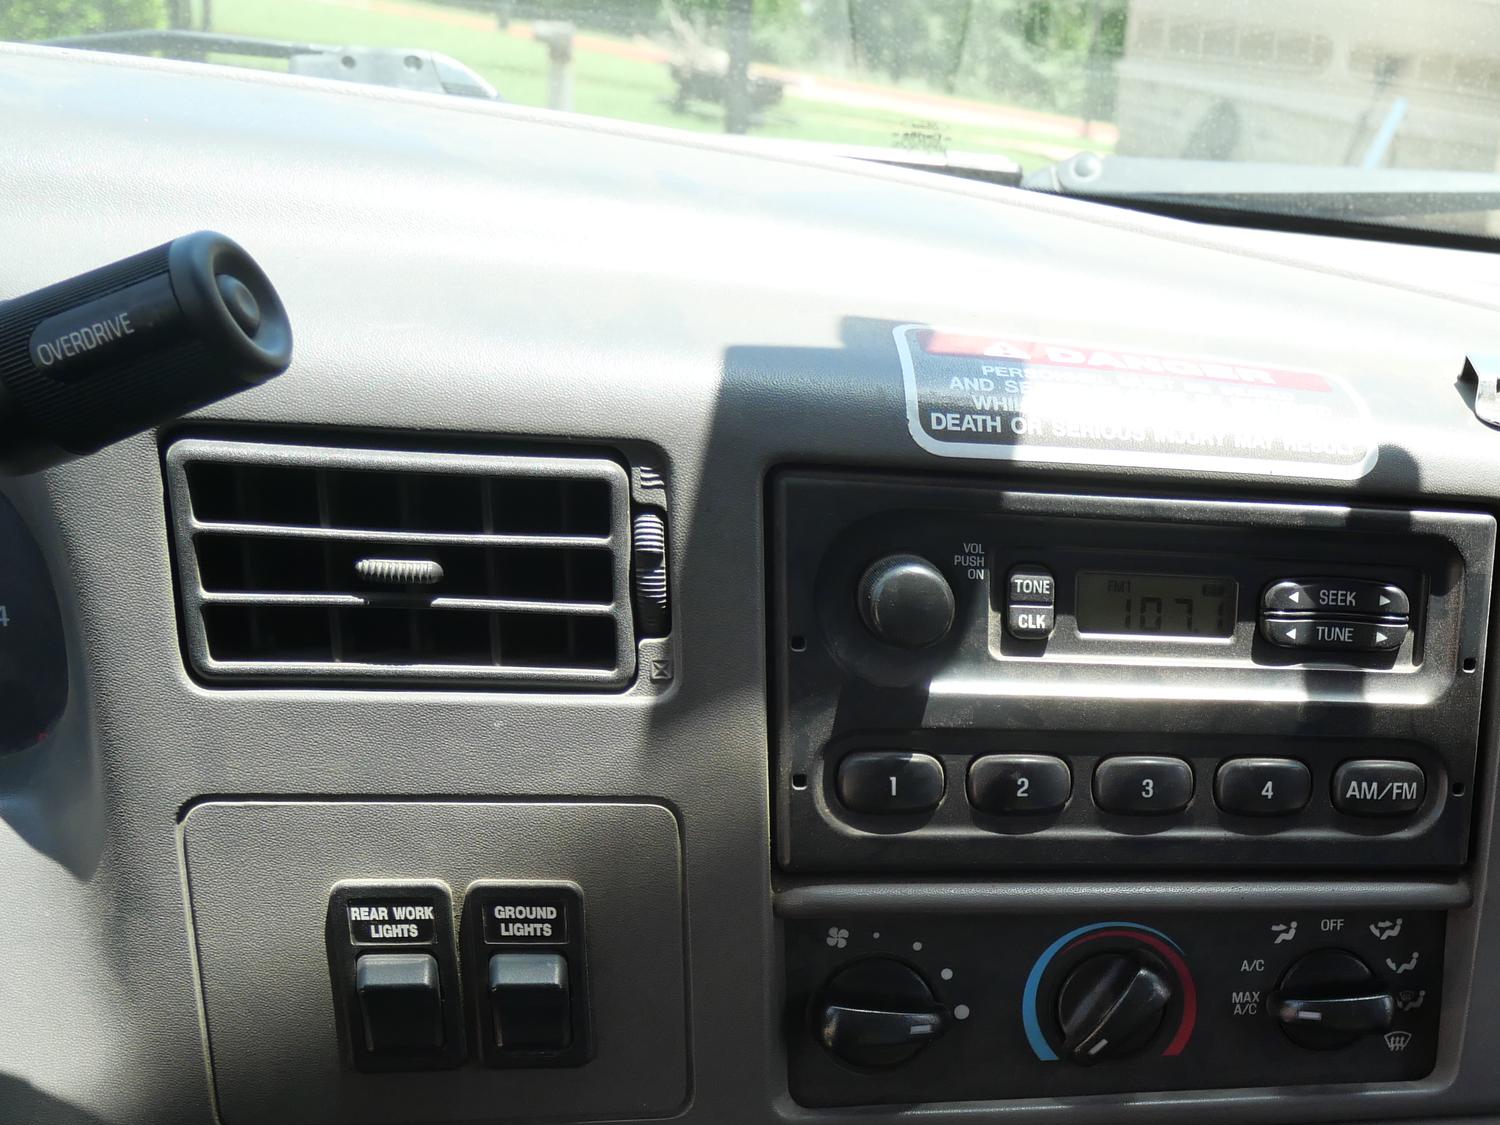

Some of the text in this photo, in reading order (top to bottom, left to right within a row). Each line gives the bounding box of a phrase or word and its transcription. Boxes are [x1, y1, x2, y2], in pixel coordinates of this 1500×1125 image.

[36, 312, 135, 367] OVERDRIVE
[949, 375, 996, 393] AND
[931, 412, 1001, 435] DEATH
[1011, 415, 1042, 437] OR
[963, 542, 985, 554] VOL
[954, 555, 985, 567] PUSH
[967, 568, 985, 580] ON
[1014, 579, 1051, 594] TONE
[1319, 588, 1356, 606] SEEK
[1018, 614, 1046, 629] CLK
[1316, 626, 1354, 643] TUNE
[888, 776, 898, 797] 1
[1016, 777, 1030, 798] 2
[1141, 778, 1155, 799] 3
[1260, 780, 1274, 799] 4
[1345, 779, 1418, 800] AM/FM
[351, 906, 435, 921] REAR WORK
[494, 905, 557, 920] GROUND
[370, 924, 418, 938] LIGHTS
[501, 922, 552, 937] LIGHTS
[1320, 918, 1344, 932] OFF
[1240, 959, 1265, 973] A/C
[1231, 992, 1260, 1004] MAX
[1232, 1003, 1258, 1015] A/C
